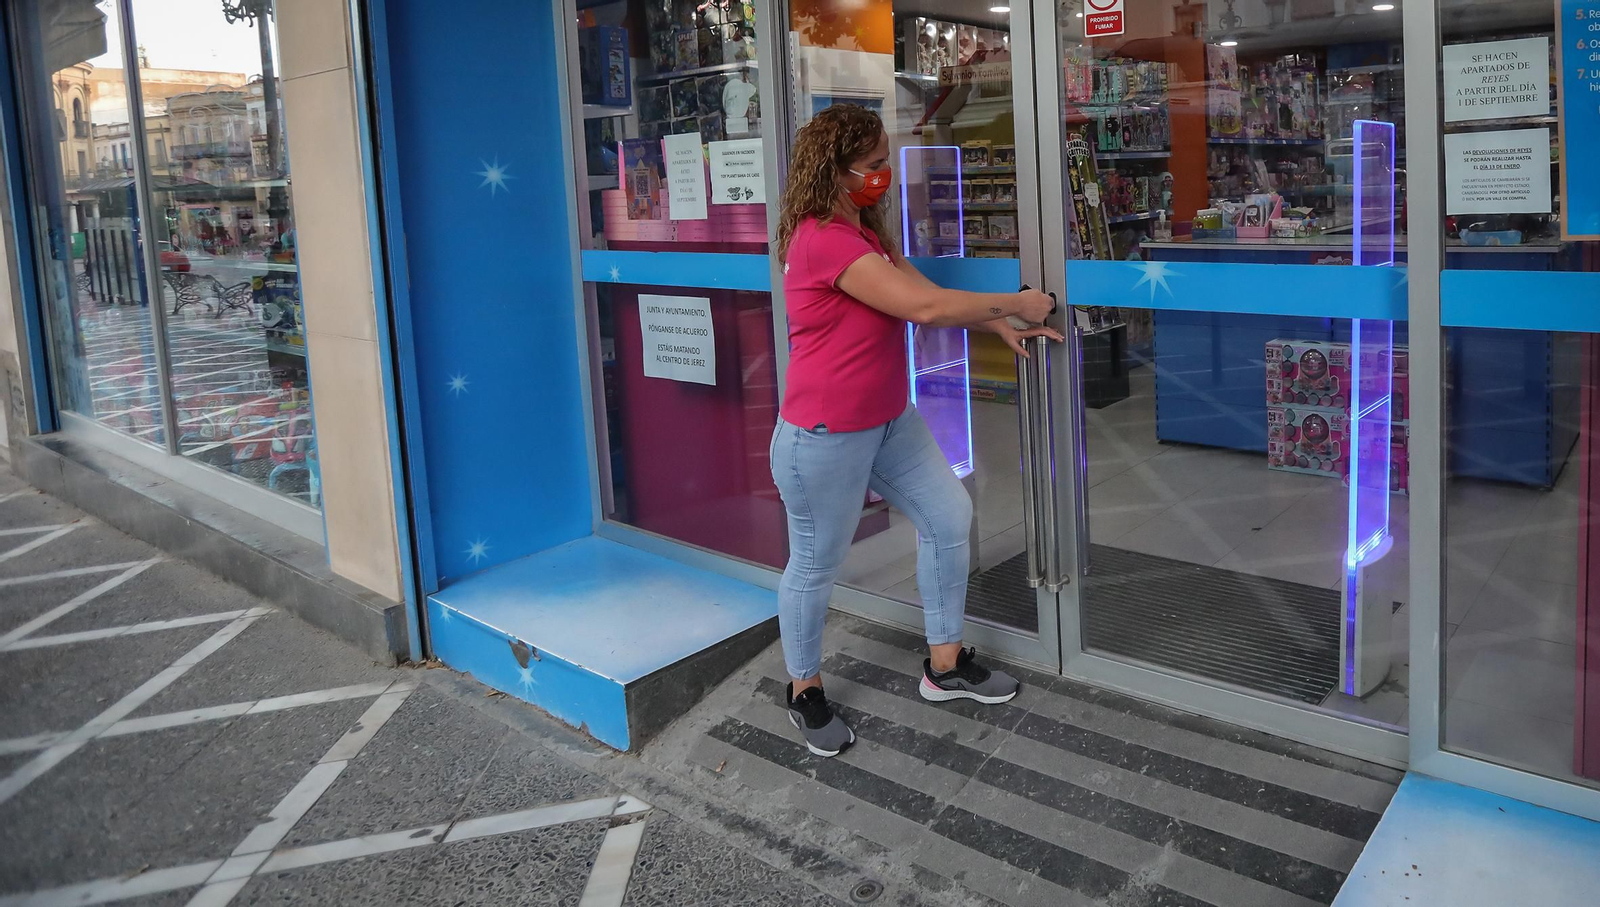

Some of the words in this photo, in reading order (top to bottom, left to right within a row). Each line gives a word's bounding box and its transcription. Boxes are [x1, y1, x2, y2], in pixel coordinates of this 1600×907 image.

[1576, 8, 1587, 20] 5.
[1576, 38, 1588, 50] 6.
[1485, 52, 1518, 61] HACEN
[1460, 63, 1515, 74] APARTADOS
[1577, 69, 1588, 79] 7.
[1481, 74, 1510, 84] REYES
[1464, 87, 1497, 95] PARTIR
[1519, 81, 1537, 91] DÍA
[1479, 94, 1538, 105] SEPTIEMBRE
[1067, 140, 1088, 148] SPARKLY
[1068, 148, 1090, 156] CRITTERS
[648, 323, 674, 333] PÓNGANSE
[683, 327, 708, 336] ACUERDO
[658, 343, 673, 352] ESTÁIS
[674, 346, 700, 355] MATANDO
[662, 356, 682, 364] CENTRO
[691, 358, 705, 367] JEREZ
